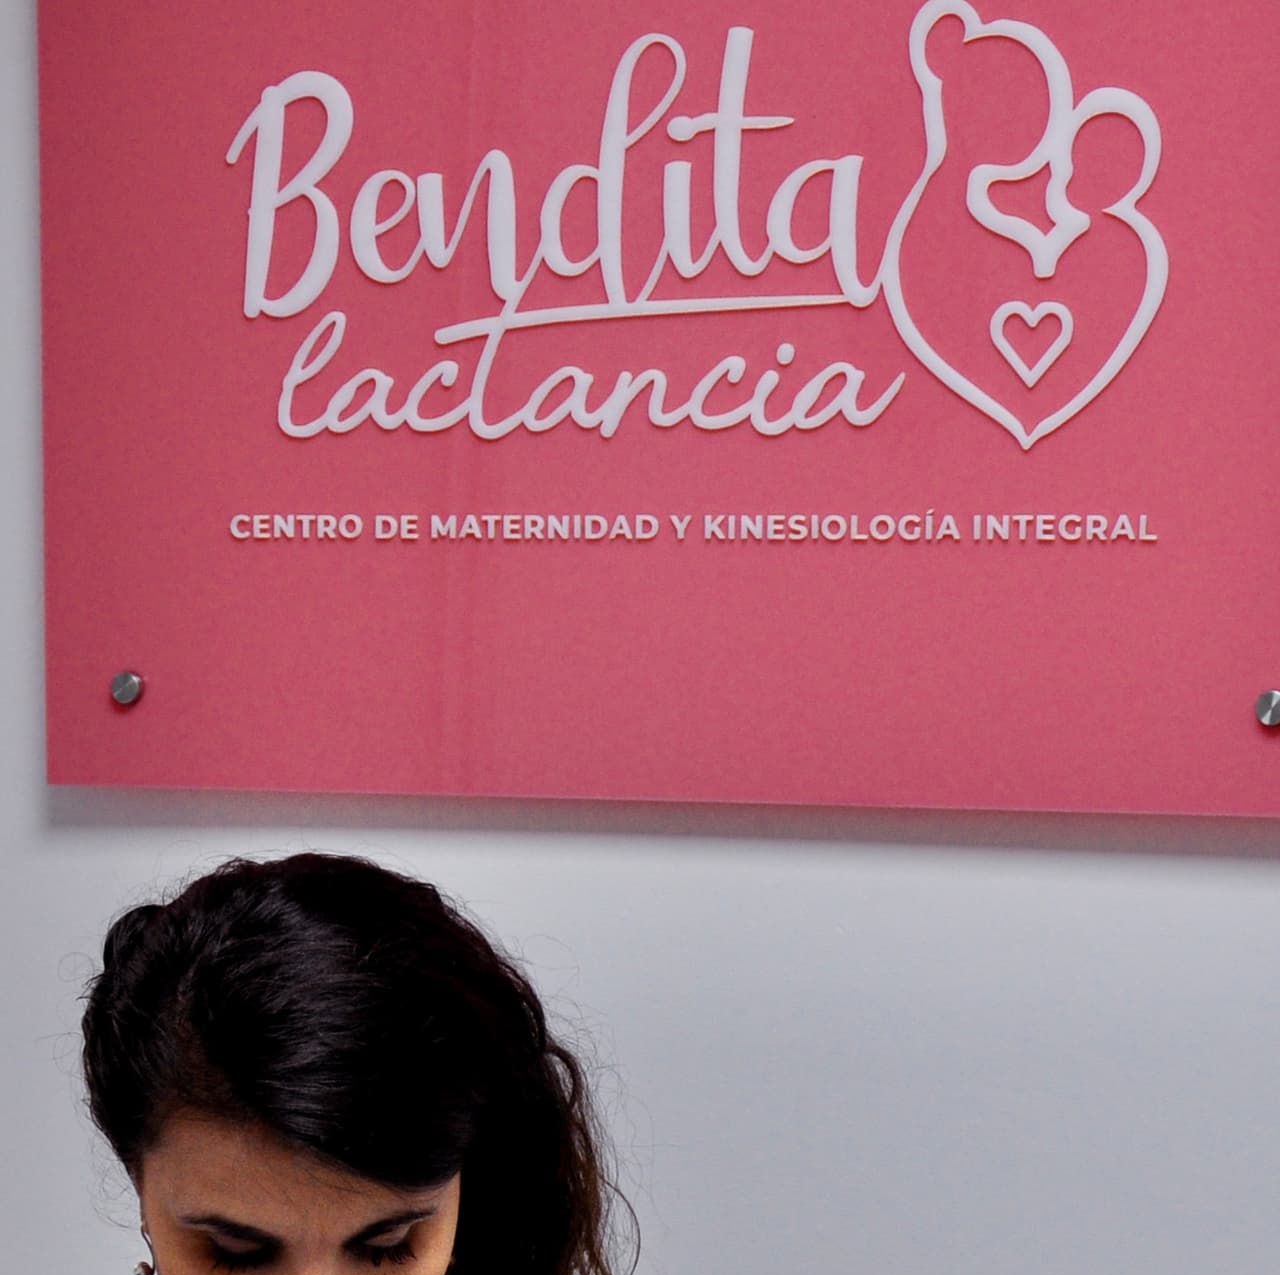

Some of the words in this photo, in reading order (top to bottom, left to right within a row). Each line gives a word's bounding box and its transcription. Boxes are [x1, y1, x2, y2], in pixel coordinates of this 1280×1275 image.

[226, 26, 888, 319] Bendita
[276, 310, 907, 441] lactancia
[230, 514, 363, 539] CENTRO
[375, 514, 419, 539] DE
[431, 513, 659, 540] MATERNIDAD
[670, 514, 692, 539] Y
[704, 508, 961, 541] KINESIOLOGÍA
[973, 513, 1158, 541] INTEGRAL
